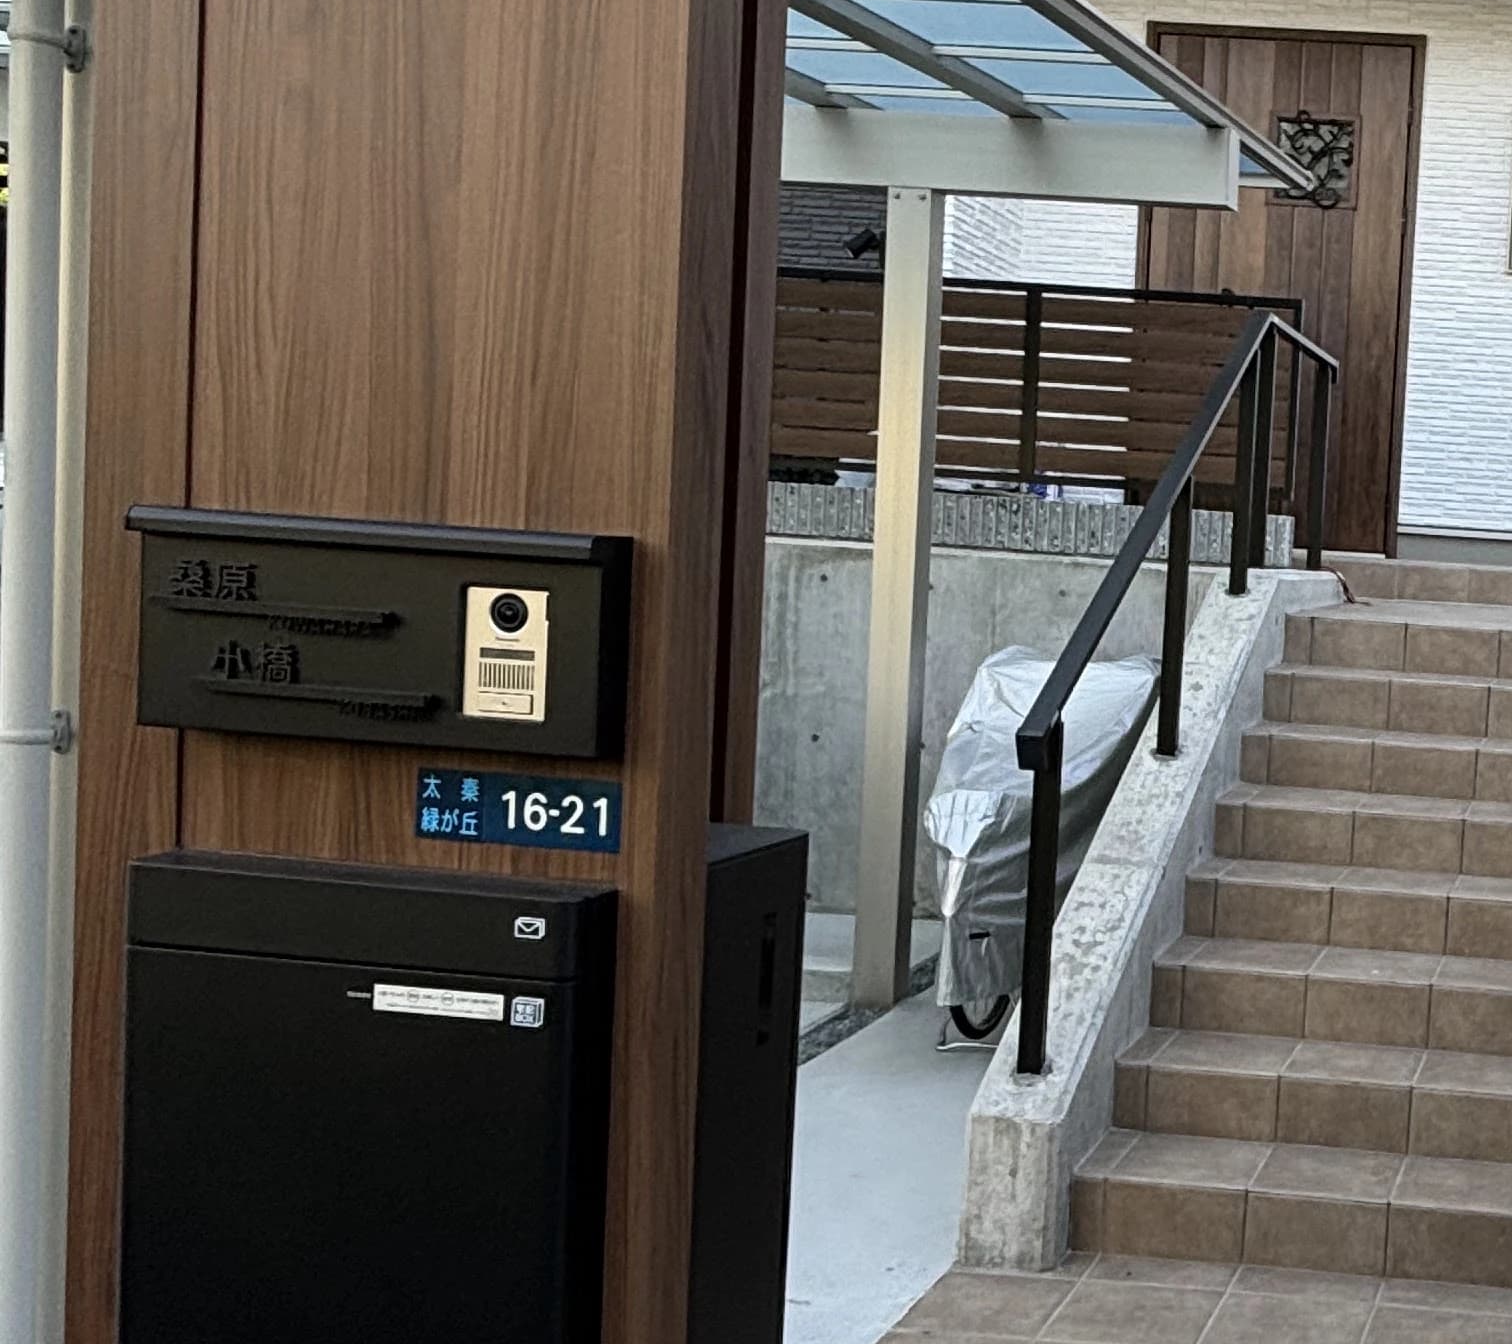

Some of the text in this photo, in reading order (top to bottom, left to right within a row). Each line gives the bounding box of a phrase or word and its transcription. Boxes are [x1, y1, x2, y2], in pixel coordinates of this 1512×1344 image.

[170, 560, 257, 601] 桑原
[420, 806, 479, 836] 緑が丘
[501, 790, 608, 837] 16-21
